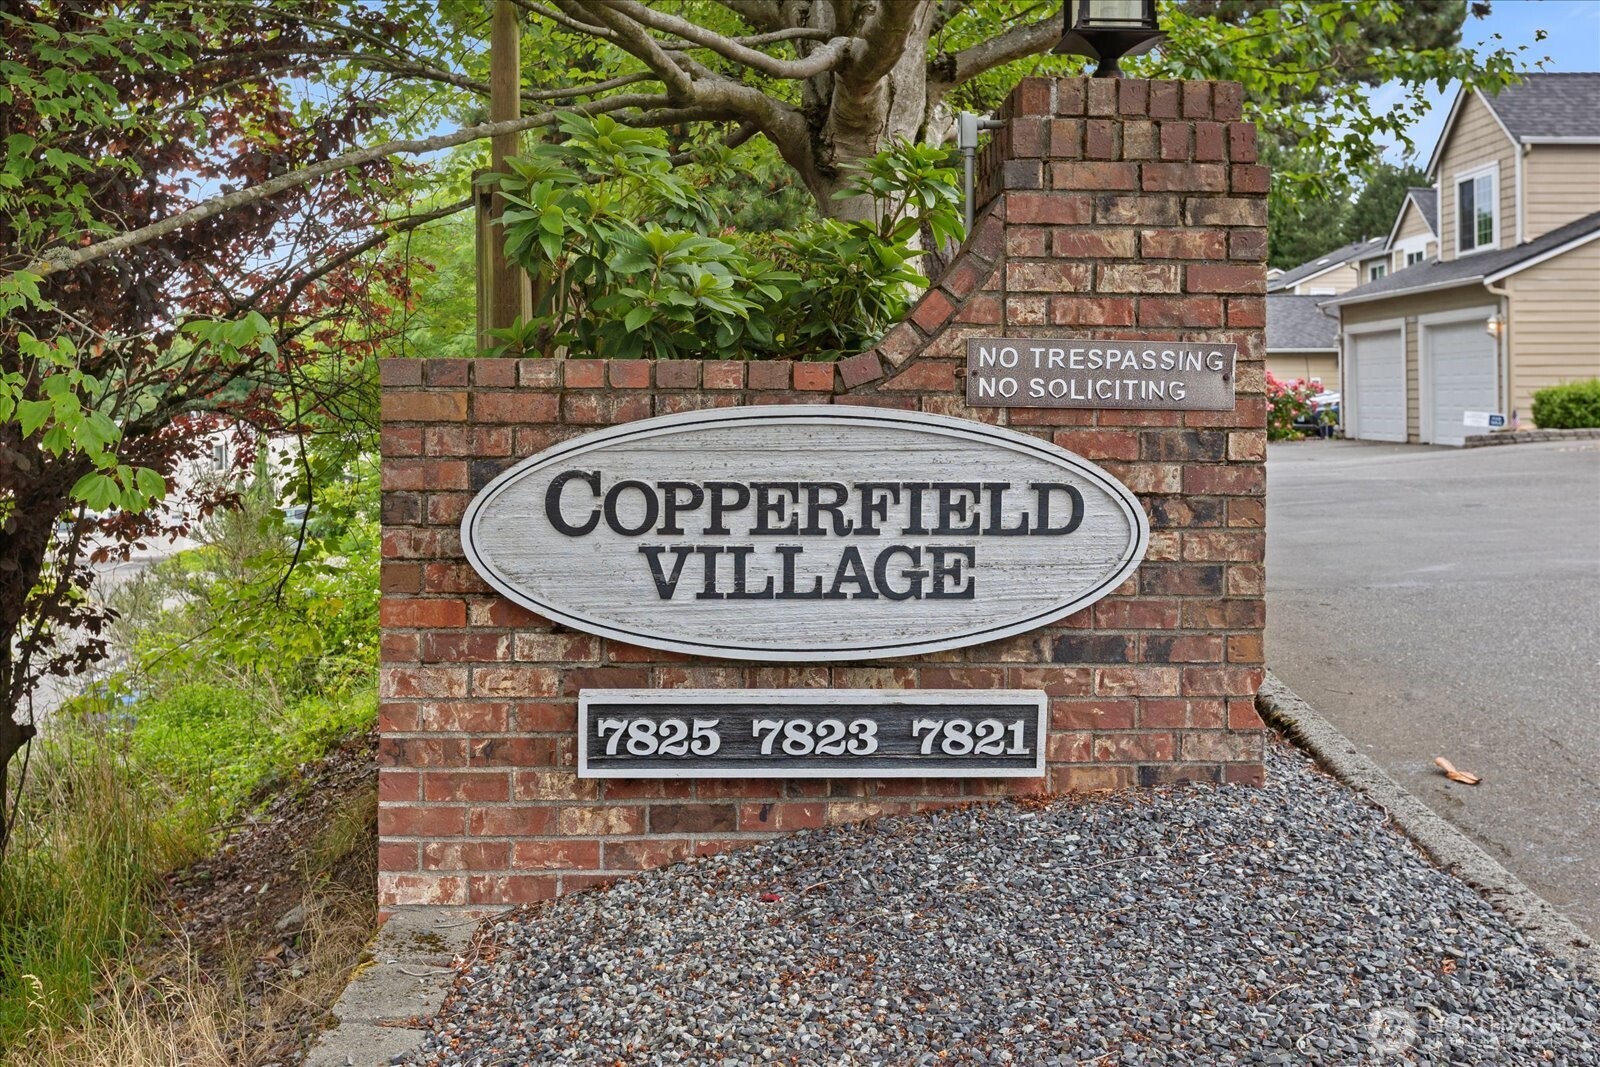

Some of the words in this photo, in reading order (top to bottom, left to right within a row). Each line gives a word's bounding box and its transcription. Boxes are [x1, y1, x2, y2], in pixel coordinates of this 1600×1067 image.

[978, 347, 1019, 368] NO
[1029, 348, 1225, 371] TRESPASSING
[977, 377, 1018, 398] NO
[1028, 378, 1187, 401] SOLICITING
[544, 469, 1085, 537] COPPERFIELD
[637, 545, 976, 601] VILLAGE
[596, 717, 722, 756] 7825
[751, 718, 879, 756] 7823
[911, 719, 1030, 756] 7821
